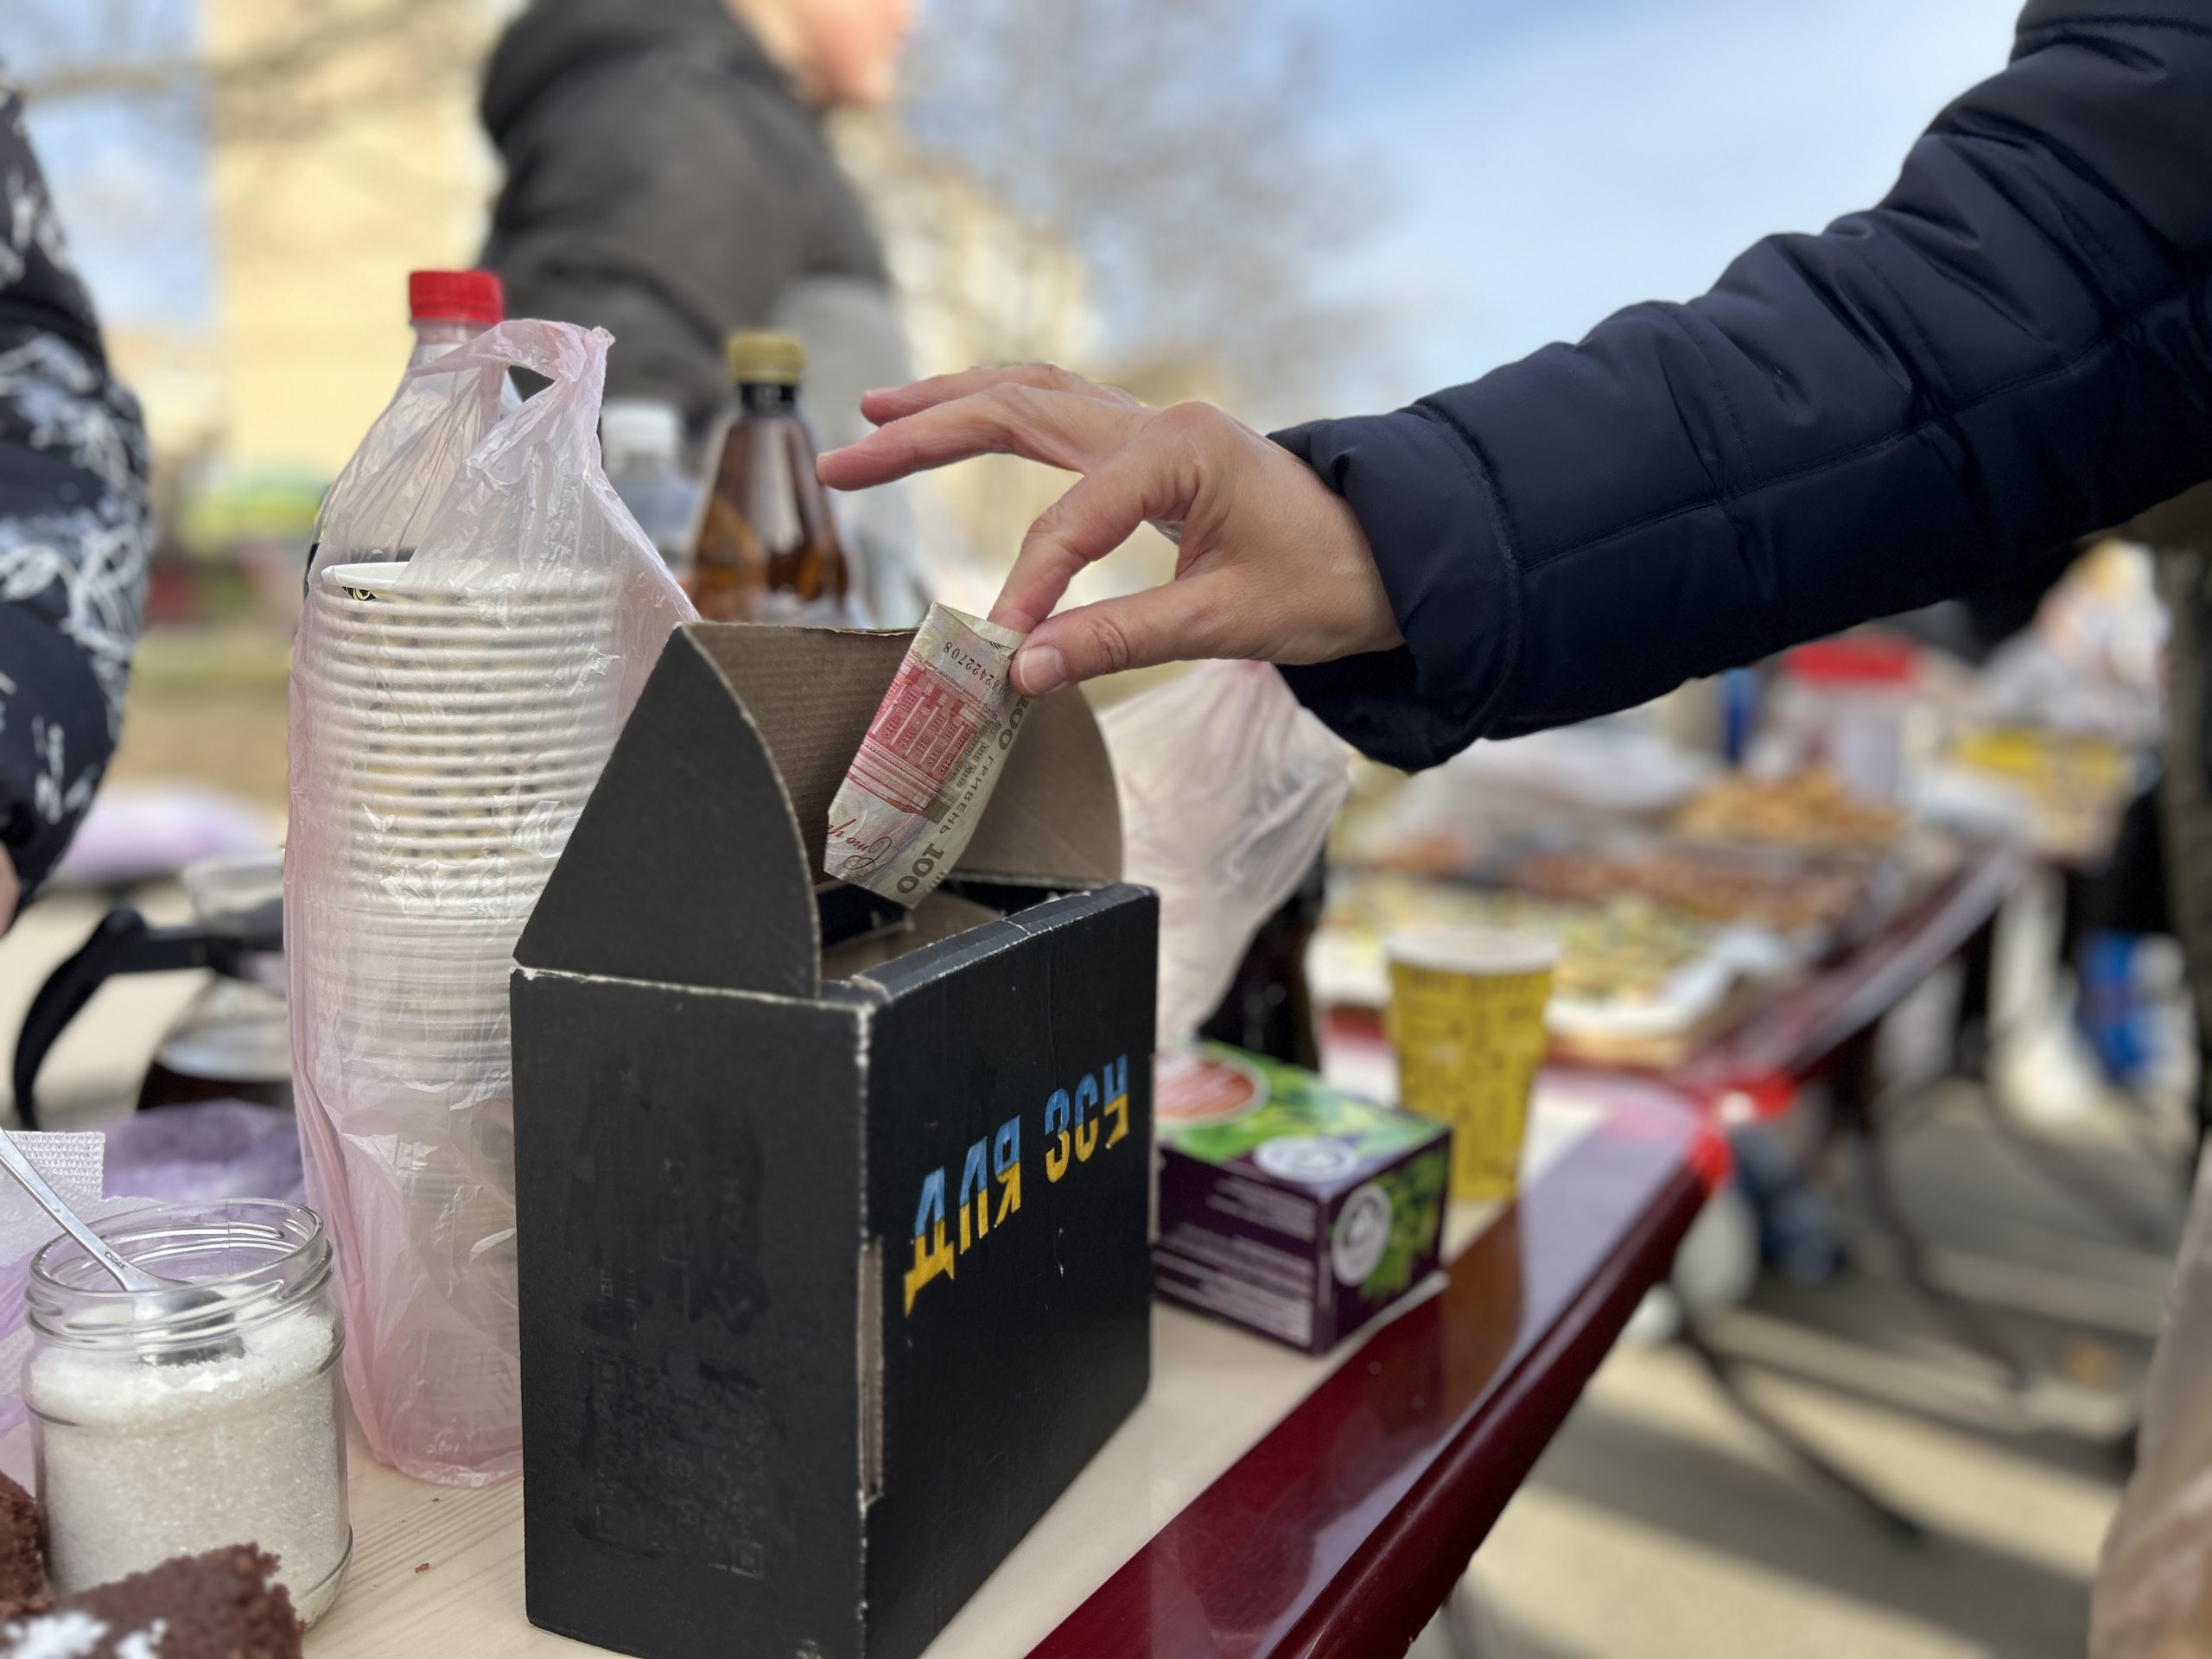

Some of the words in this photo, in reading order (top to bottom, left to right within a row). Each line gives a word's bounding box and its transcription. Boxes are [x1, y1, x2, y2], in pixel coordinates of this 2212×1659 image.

[939, 755, 995, 835] ГРИВЕНЬ
[896, 842, 945, 894] 100
[903, 1114, 1021, 1319] ДЛЯ
[1044, 1052, 1130, 1183] ЗСУ
